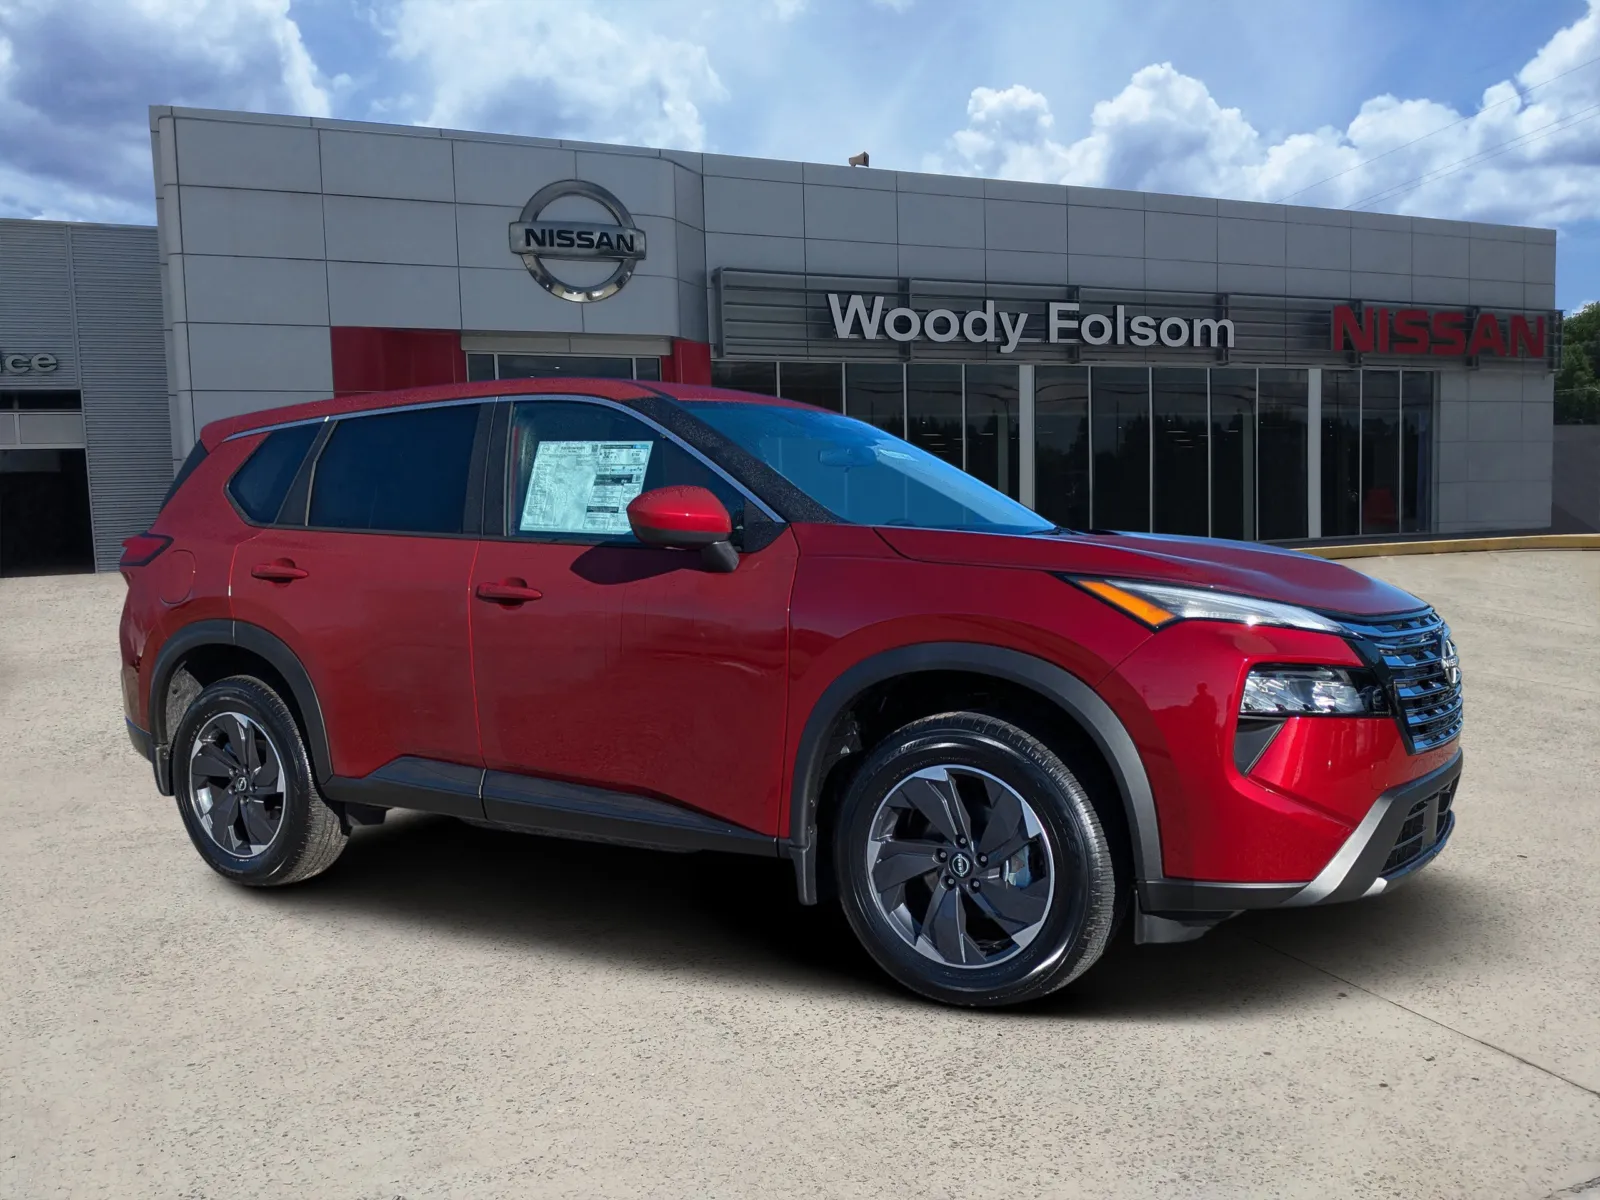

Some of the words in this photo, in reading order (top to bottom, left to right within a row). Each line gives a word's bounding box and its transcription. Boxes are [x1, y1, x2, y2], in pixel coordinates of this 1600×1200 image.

[525, 228, 634, 252] NISSAN
[827, 293, 1028, 353] Woody
[1048, 302, 1235, 348] Folsom
[1333, 304, 1545, 358] NISSAN
[2, 353, 57, 373] ce
